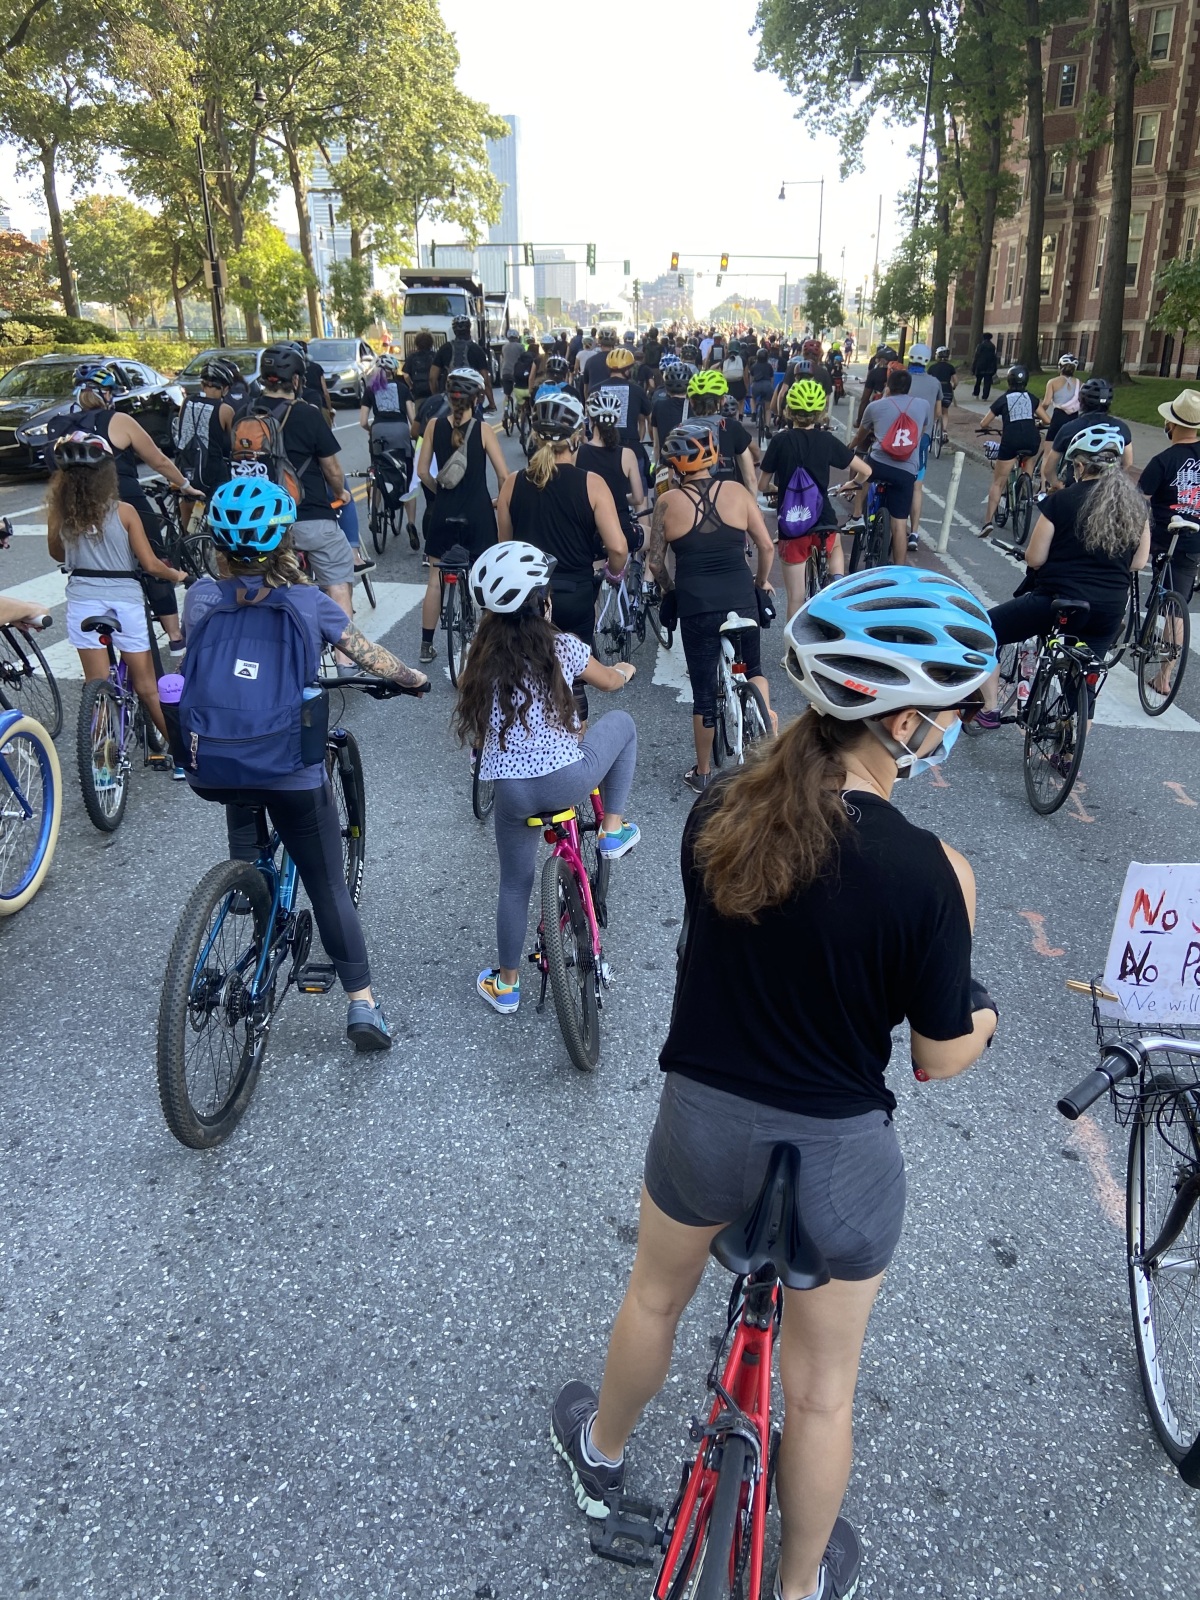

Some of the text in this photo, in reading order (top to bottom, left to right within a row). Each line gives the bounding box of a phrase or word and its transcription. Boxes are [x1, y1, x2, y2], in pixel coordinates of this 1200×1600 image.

[892, 428, 913, 447] R
[354, 859, 363, 904] MAXXIS
[1129, 887, 1179, 932] No
[1117, 940, 1159, 985] No
[1117, 990, 1199, 1012] We will
